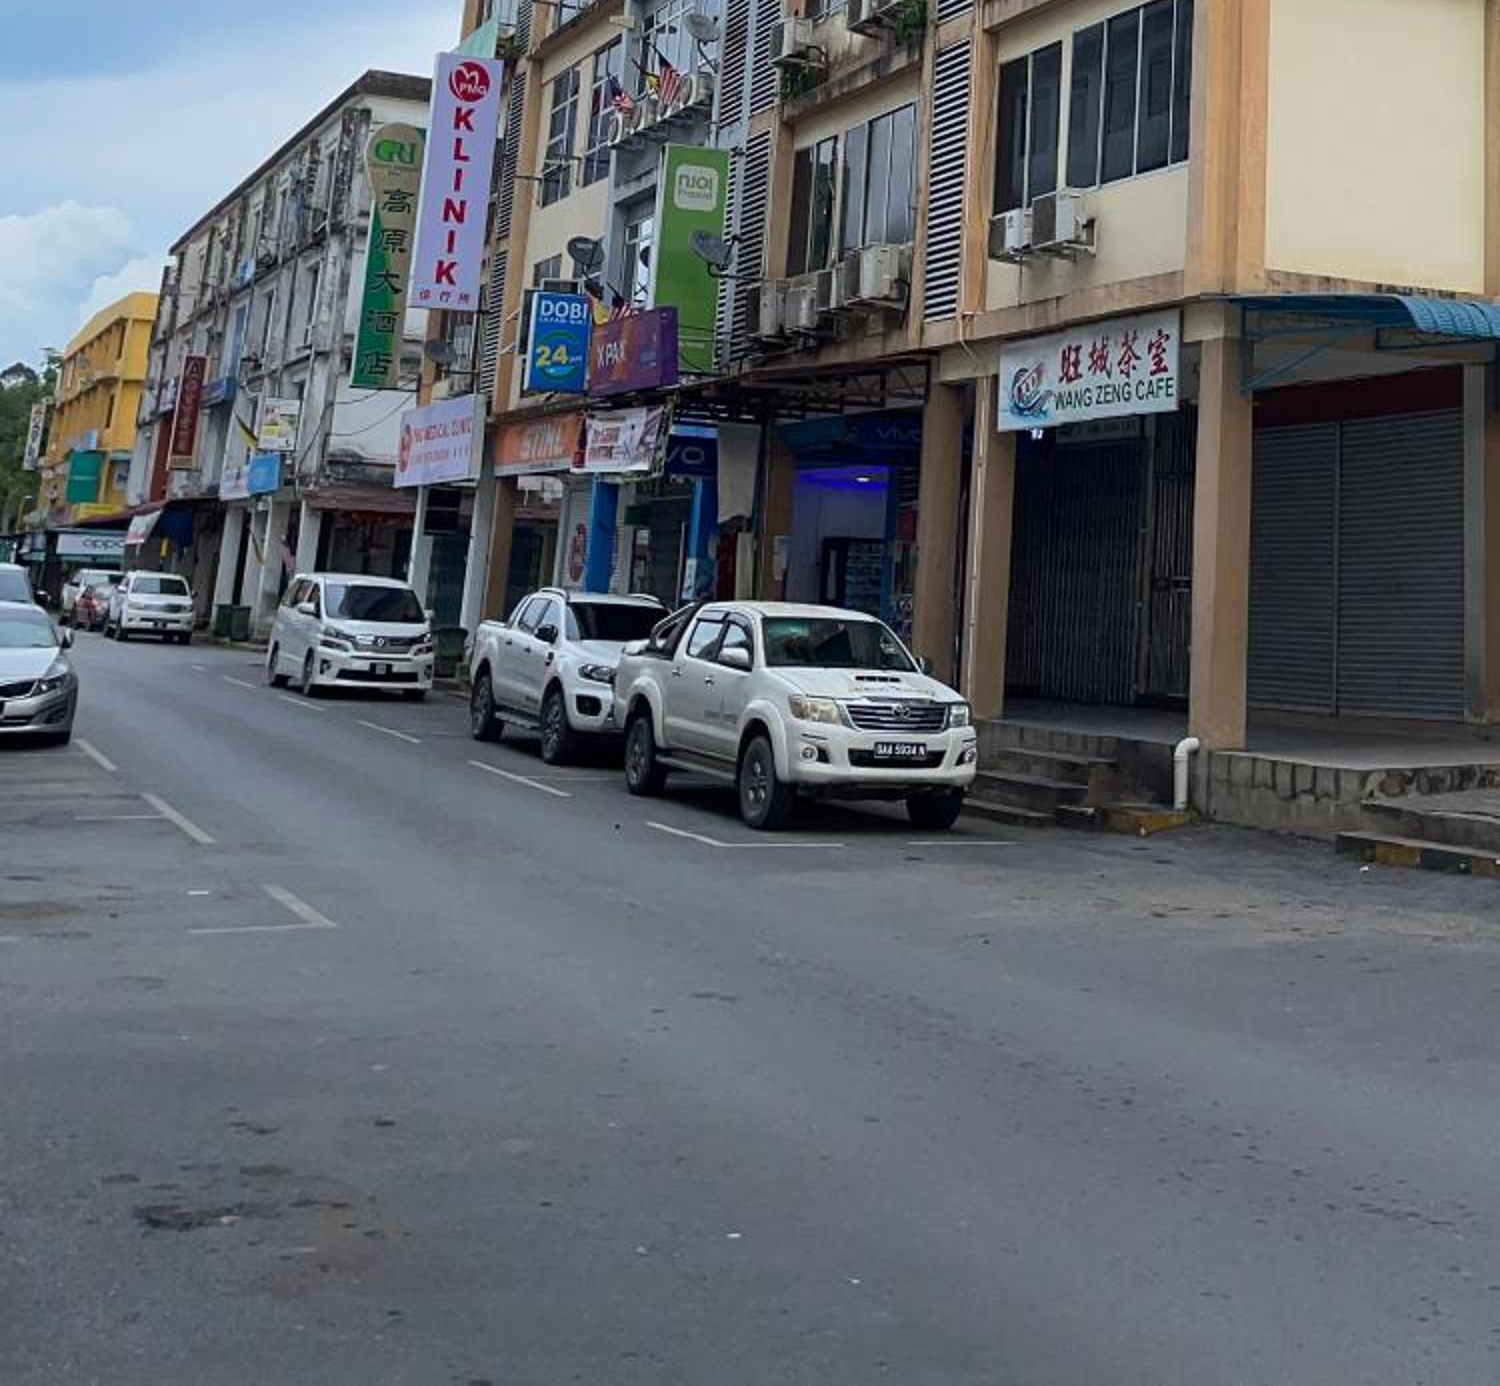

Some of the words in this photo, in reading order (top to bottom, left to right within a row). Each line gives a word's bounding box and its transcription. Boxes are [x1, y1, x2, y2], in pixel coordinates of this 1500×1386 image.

[435, 106, 475, 286] KLINIK
[360, 188, 414, 376] 高原大酒店
[541, 300, 588, 319] DOBI
[536, 343, 568, 368] 24
[1058, 328, 1171, 384] 旺城茶室
[1055, 387, 1093, 411] WANG
[1095, 382, 1131, 405] ZENG
[1135, 377, 1174, 401] CAFE
